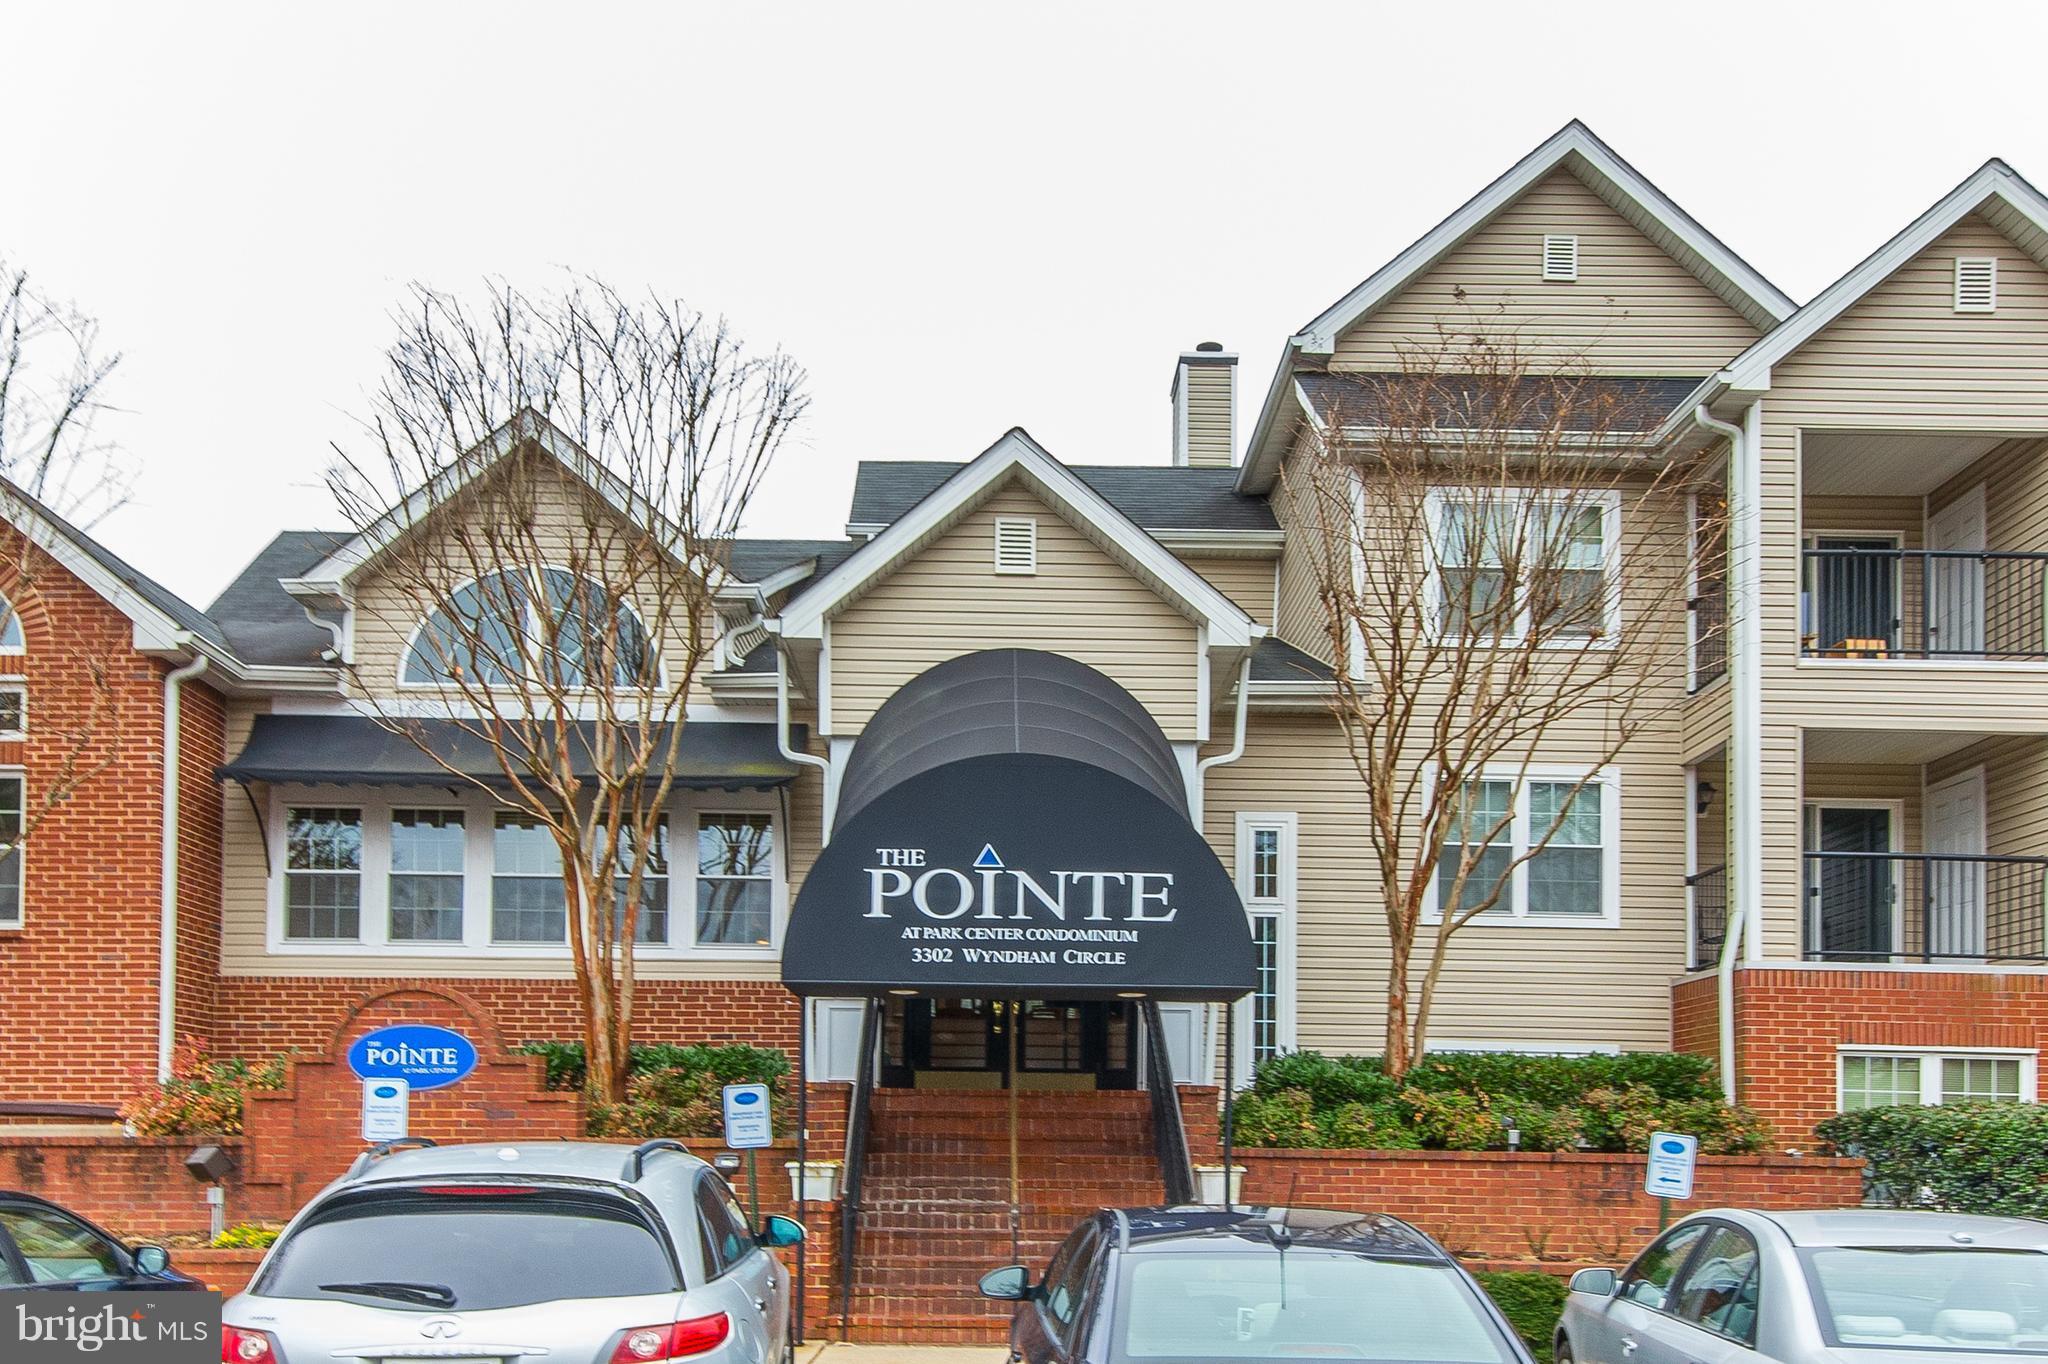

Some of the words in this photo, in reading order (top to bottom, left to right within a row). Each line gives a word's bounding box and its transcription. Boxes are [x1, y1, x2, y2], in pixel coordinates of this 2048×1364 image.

[876, 848, 926, 867] THE
[862, 867, 1178, 923] POINTE
[901, 927, 922, 939] AT
[923, 927, 963, 940] PARK
[964, 927, 1024, 941] CENTER
[1025, 928, 1139, 943] CONDOMINIUM
[911, 948, 953, 963] 3302
[366, 1047, 458, 1066] POINTE
